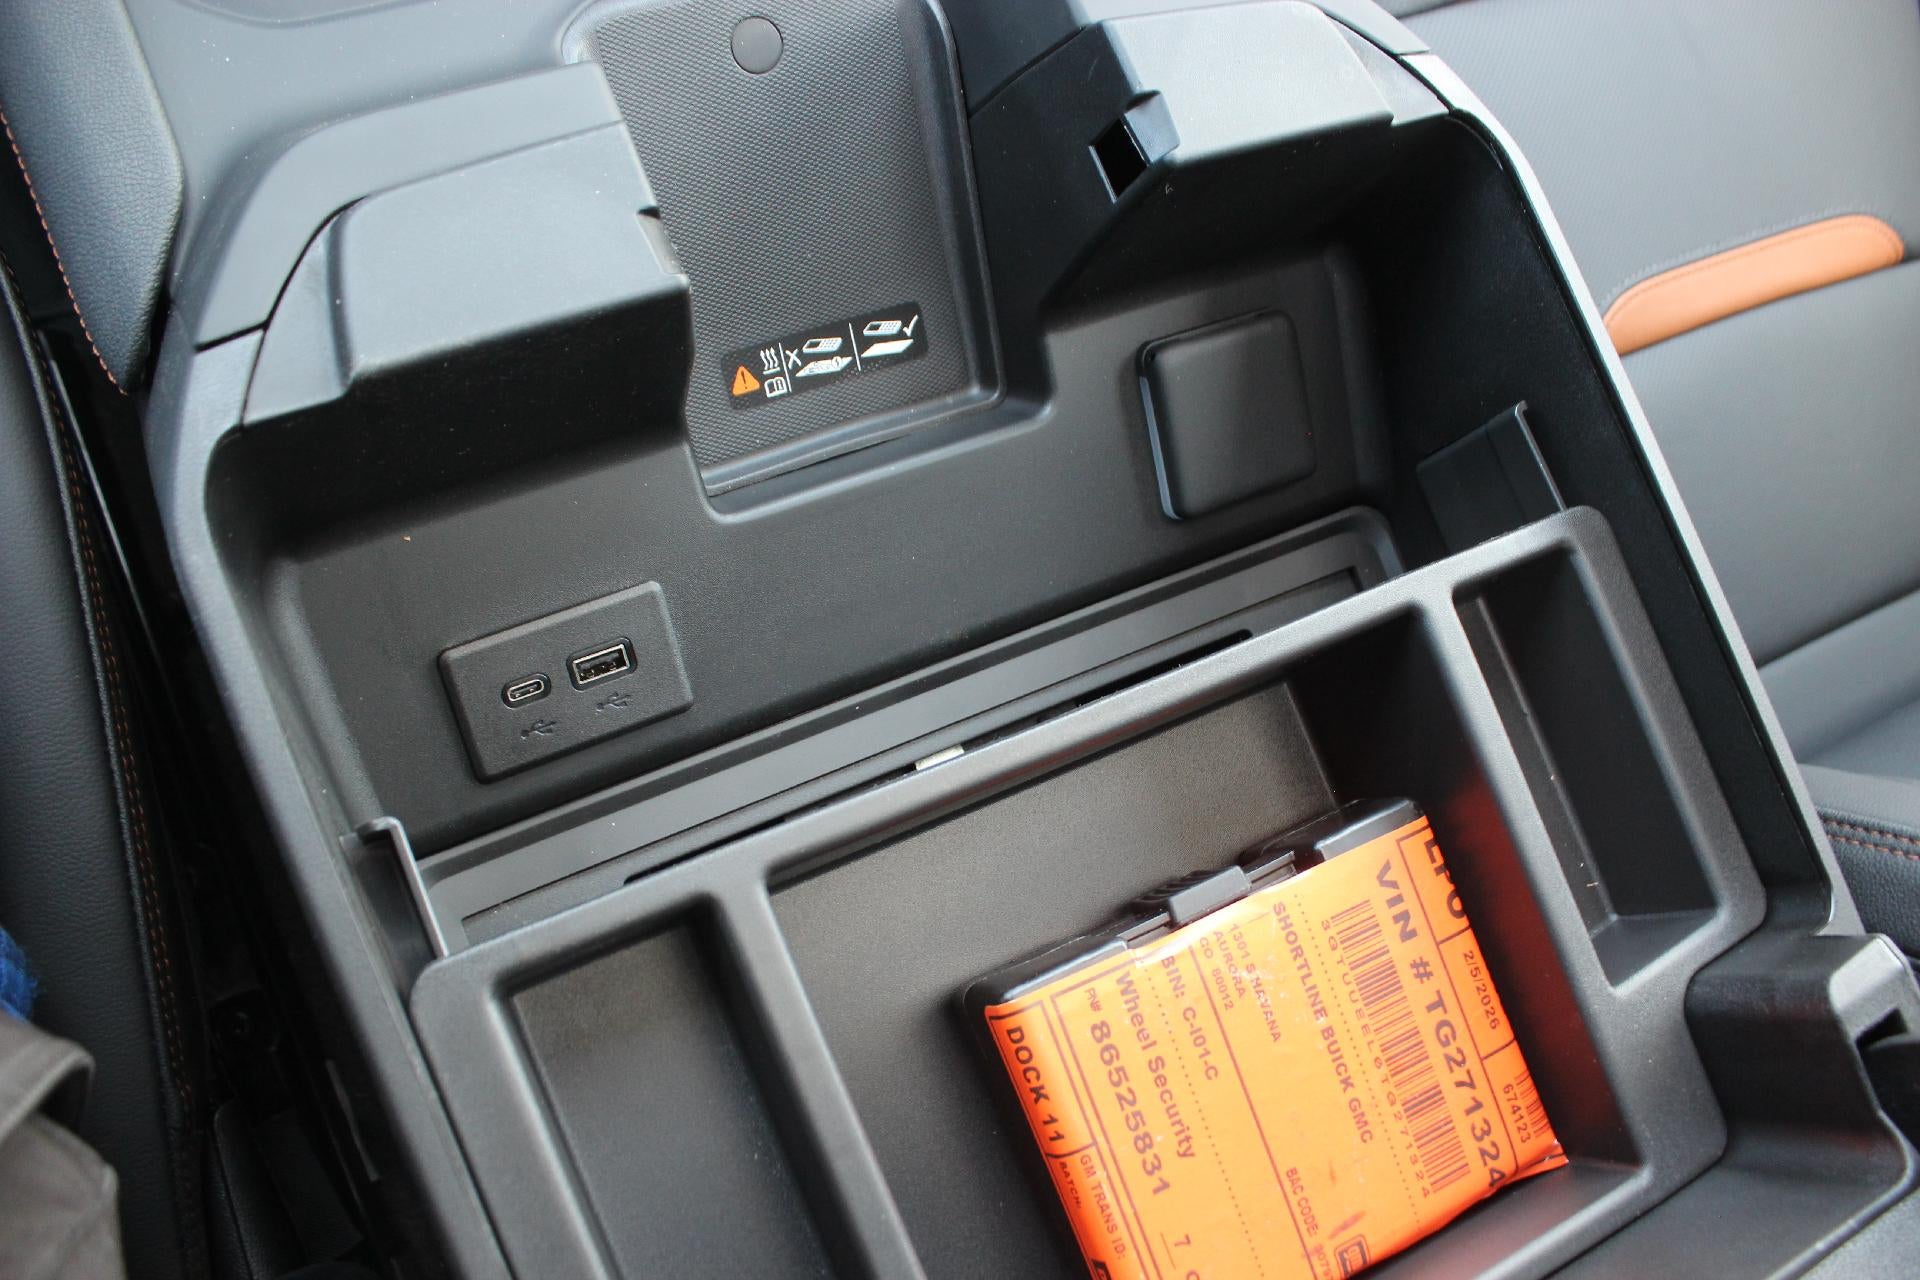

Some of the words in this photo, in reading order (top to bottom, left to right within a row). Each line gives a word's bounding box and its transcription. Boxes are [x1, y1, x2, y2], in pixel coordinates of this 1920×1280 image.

[1160, 955, 1185, 999] BIN:
[1200, 937, 1213, 959] CO
[1212, 968, 1234, 1011] 80012
[1213, 932, 1246, 998] AURORA
[1229, 924, 1250, 959] 1301
[1245, 963, 1256, 974] S
[1250, 976, 1281, 1043] HAVANA
[1273, 902, 1328, 1021] SHORTLINE
[1320, 1025, 1355, 1094] BUICK
[1348, 1097, 1373, 1144] GMC
[1376, 859, 1419, 943] VIN
[1409, 956, 1434, 984] #
[1425, 989, 1507, 1188] TG271324
[1462, 950, 1500, 1030] 2/5/2026
[1006, 1025, 1050, 1105] DOCK
[1042, 1113, 1066, 1142] 11
[1116, 970, 1157, 1051] Wheel
[1148, 1055, 1196, 1158] Security
[1090, 1020, 1171, 1196] 86525831
[1502, 1083, 1531, 1143] 674123
[1059, 1162, 1081, 1208] BATCH:
[1080, 1154, 1096, 1178] GM
[1091, 1181, 1118, 1234] TRANS
[1112, 1238, 1126, 1259] ID:
[1285, 1167, 1304, 1195] BAC
[1297, 1197, 1319, 1237] CODE:
